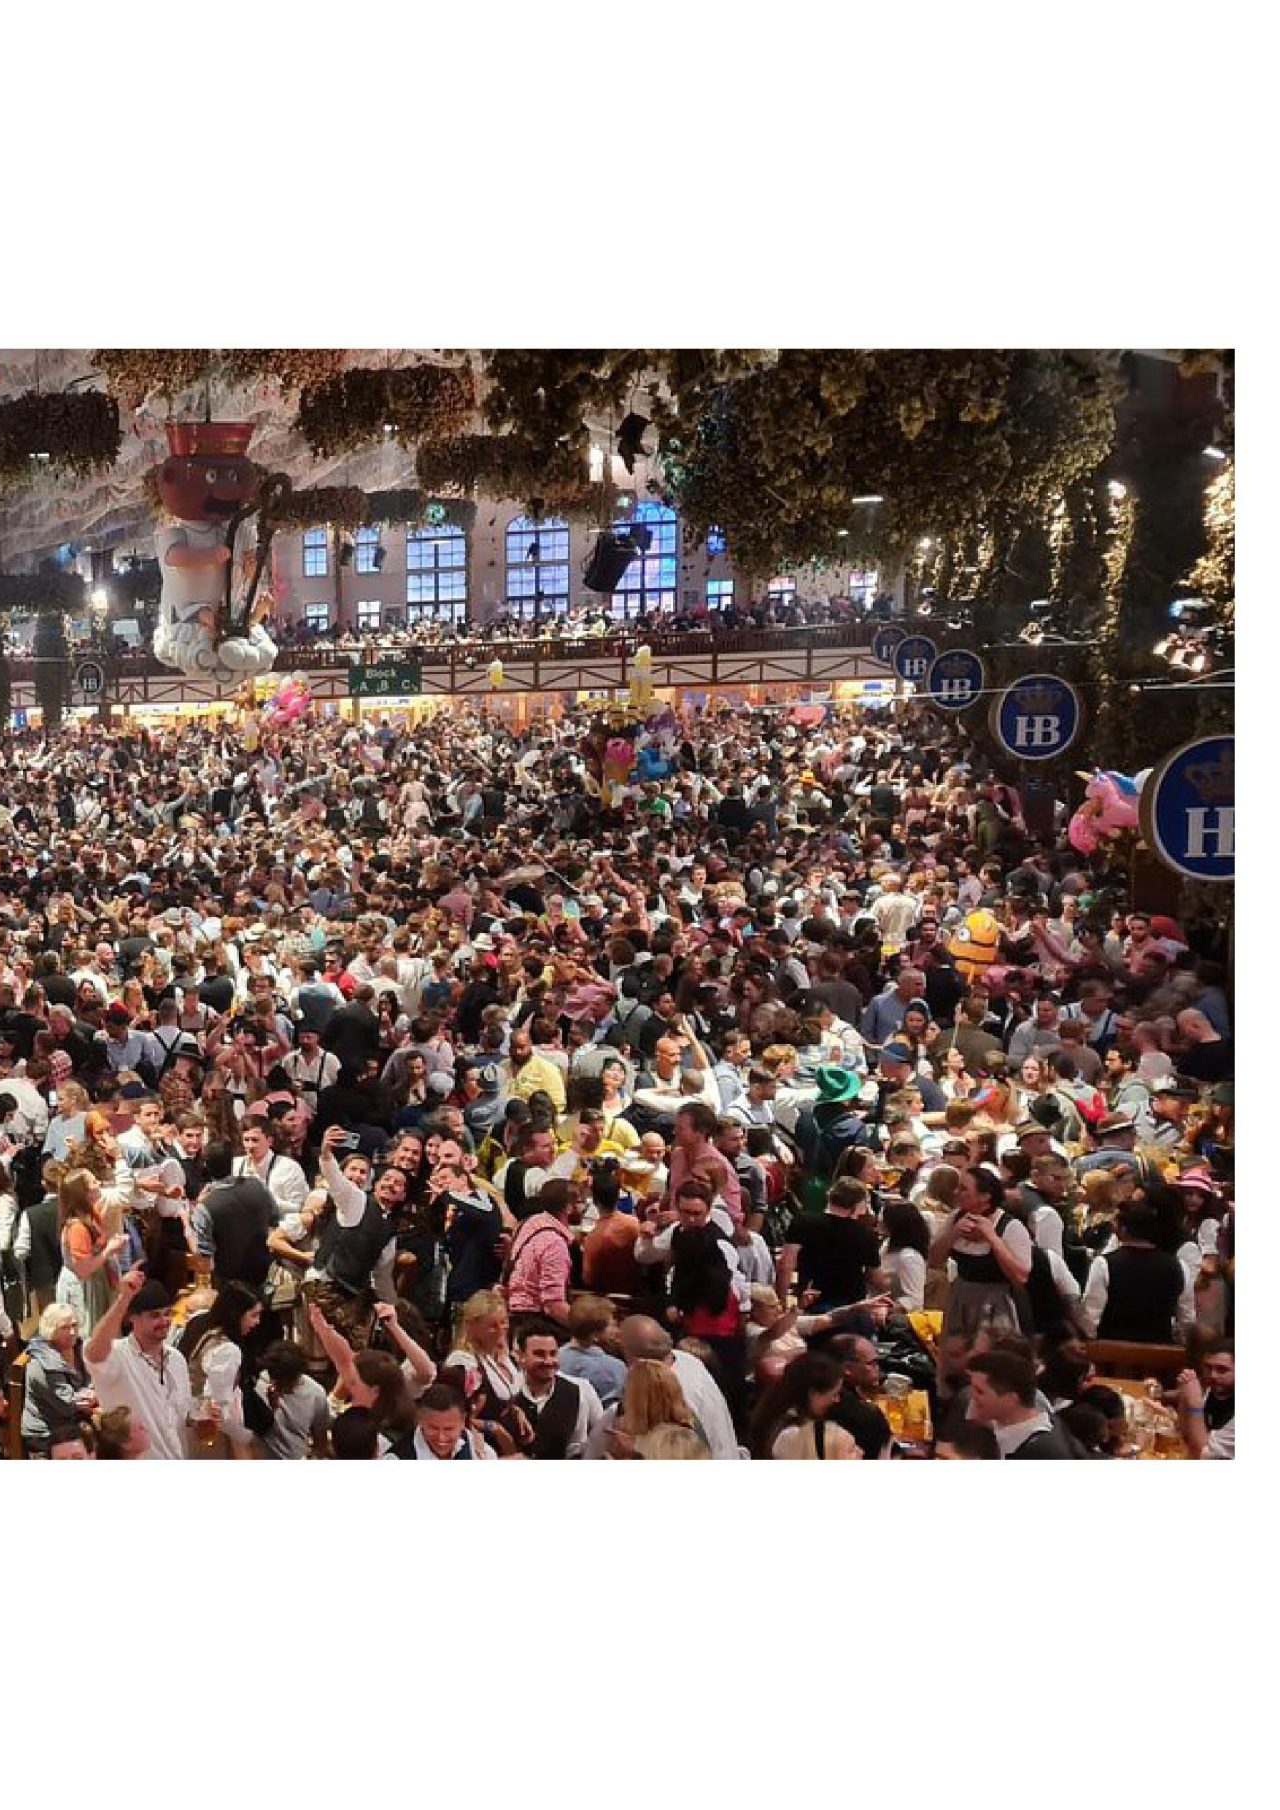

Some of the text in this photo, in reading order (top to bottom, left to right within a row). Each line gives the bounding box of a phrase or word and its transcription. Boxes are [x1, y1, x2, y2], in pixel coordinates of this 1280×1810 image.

[366, 667, 397, 679] Block
[904, 658, 927, 676] HB
[83, 677, 98, 690] HB
[359, 681, 370, 692] A
[401, 679, 411, 689] C
[941, 677, 971, 700] HB
[1014, 714, 1062, 746] HB
